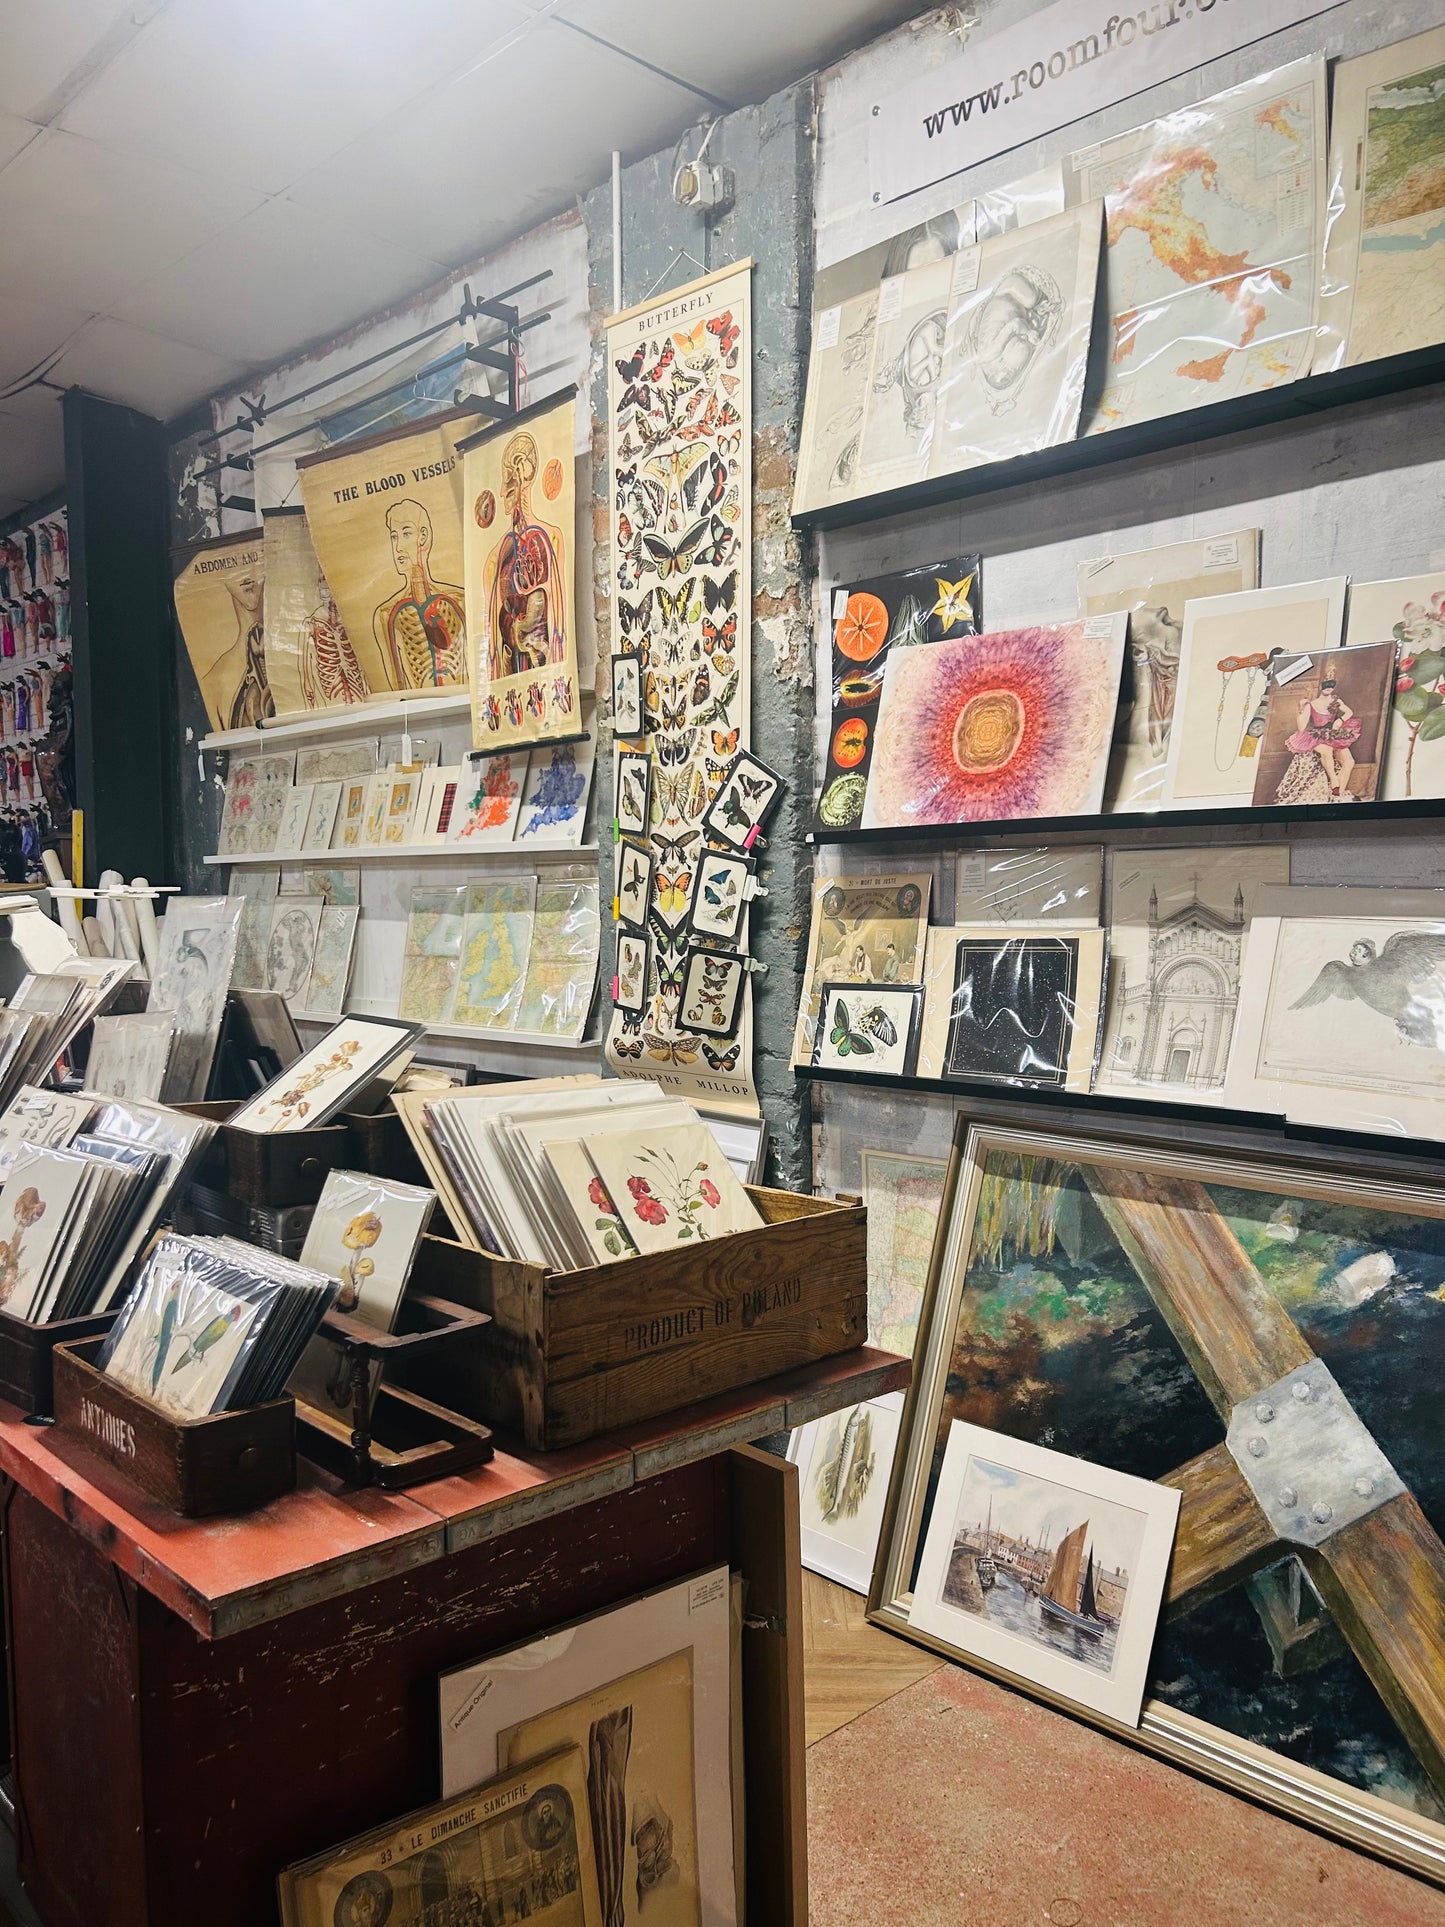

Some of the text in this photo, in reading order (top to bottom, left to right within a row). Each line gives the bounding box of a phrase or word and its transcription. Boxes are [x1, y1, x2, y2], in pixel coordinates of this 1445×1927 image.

[638, 292, 713, 332] BUTTERFLY
[333, 456, 456, 504] THE BLOOD VESSELS
[193, 551, 259, 575] ABDOMEN AND
[622, 1069, 682, 1085] ADOLPHE
[624, 1305, 705, 1351] PRODUCT
[714, 1297, 734, 1327] OF
[454, 1679, 494, 1729] Antique Original
[380, 1849, 393, 1865] 33
[411, 1833, 424, 1850] LE
[431, 1808, 477, 1840] DIMANCHE
